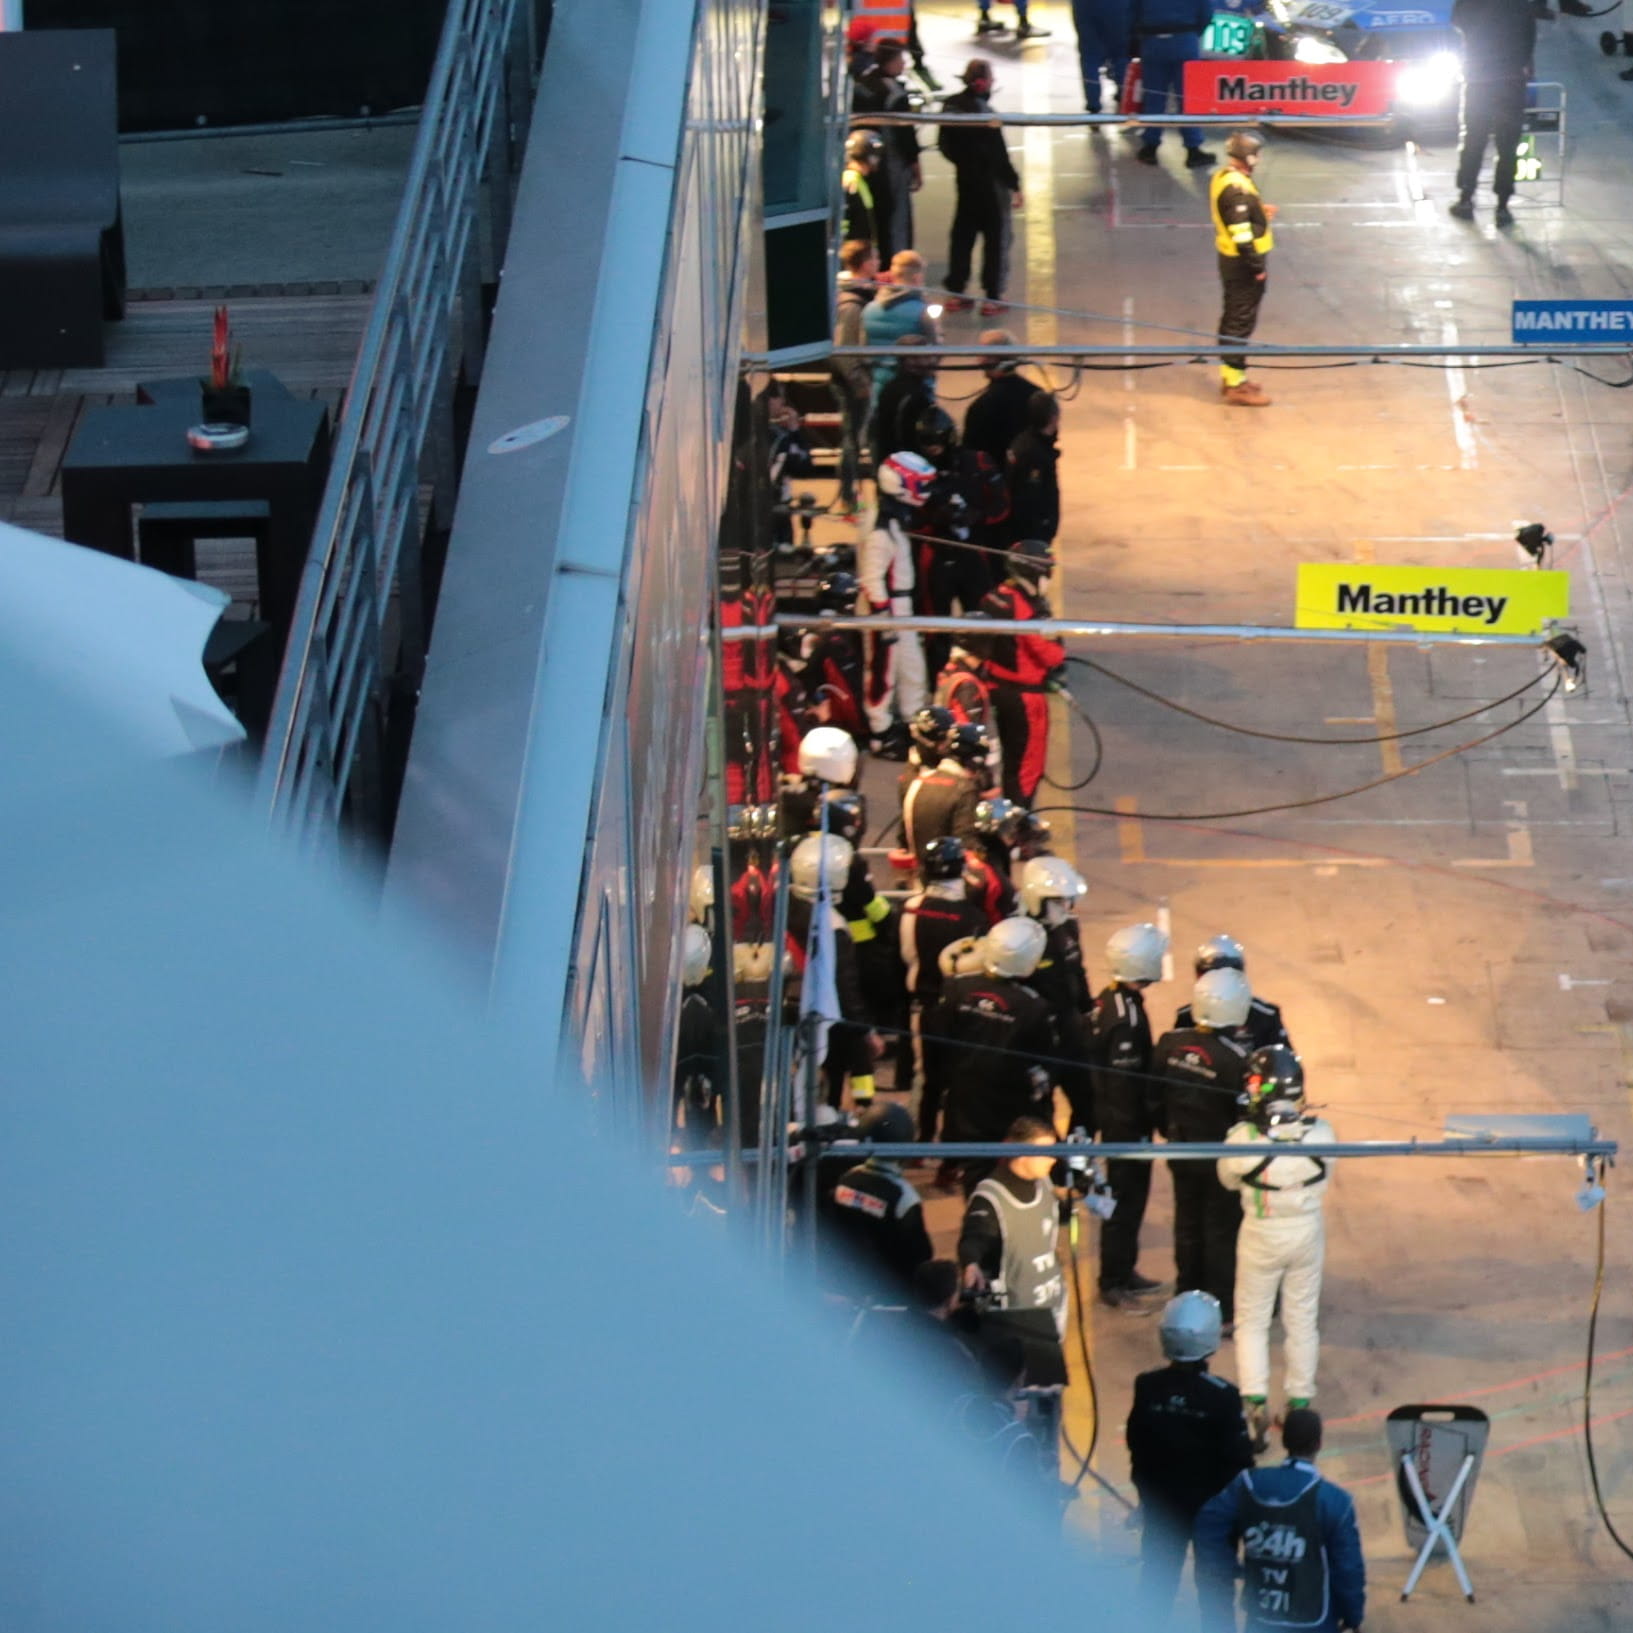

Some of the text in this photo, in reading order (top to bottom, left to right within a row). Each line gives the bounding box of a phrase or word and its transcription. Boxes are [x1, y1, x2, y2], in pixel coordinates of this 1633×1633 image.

[1217, 77, 1358, 106] Manthey
[1337, 584, 1507, 624] Manthey
[1244, 1526, 1307, 1559] 24h
